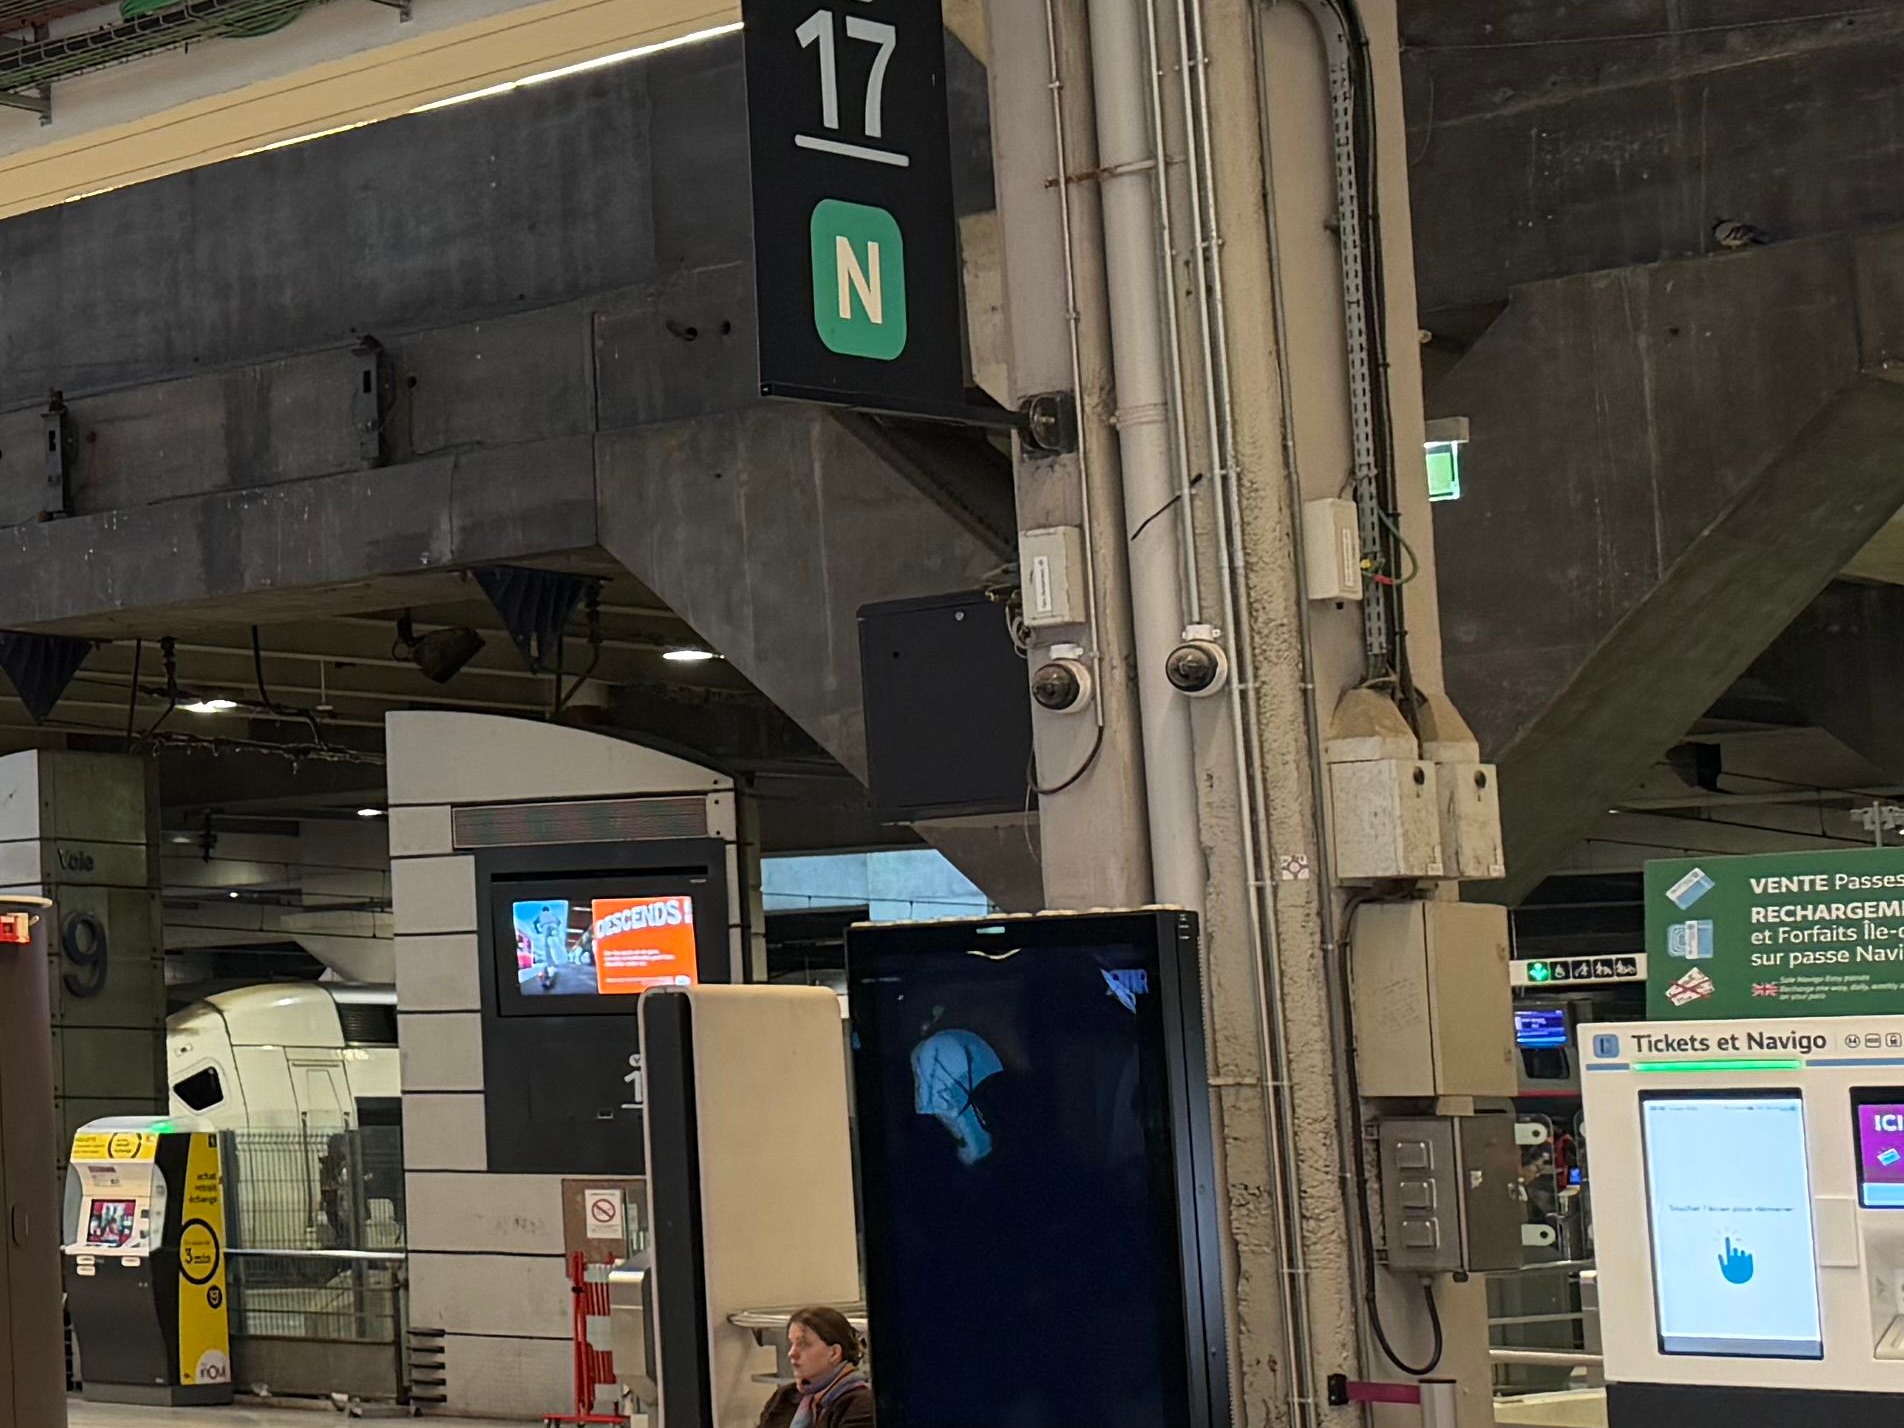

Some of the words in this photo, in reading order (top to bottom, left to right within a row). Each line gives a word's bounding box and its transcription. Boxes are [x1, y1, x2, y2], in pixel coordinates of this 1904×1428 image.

[794, 9, 897, 140] 17
[835, 234, 883, 326] N
[1749, 874, 1830, 895] VENTE
[1835, 873, 1904, 891] Passes
[1750, 928, 1773, 945] et
[1778, 925, 1858, 944] Forfaits
[61, 909, 109, 999] 9
[1750, 952, 1785, 967] sur
[1789, 949, 1850, 969] passe
[1630, 1033, 1711, 1053] Tickets
[1717, 1032, 1740, 1052] et
[1746, 1030, 1828, 1061] Navigo
